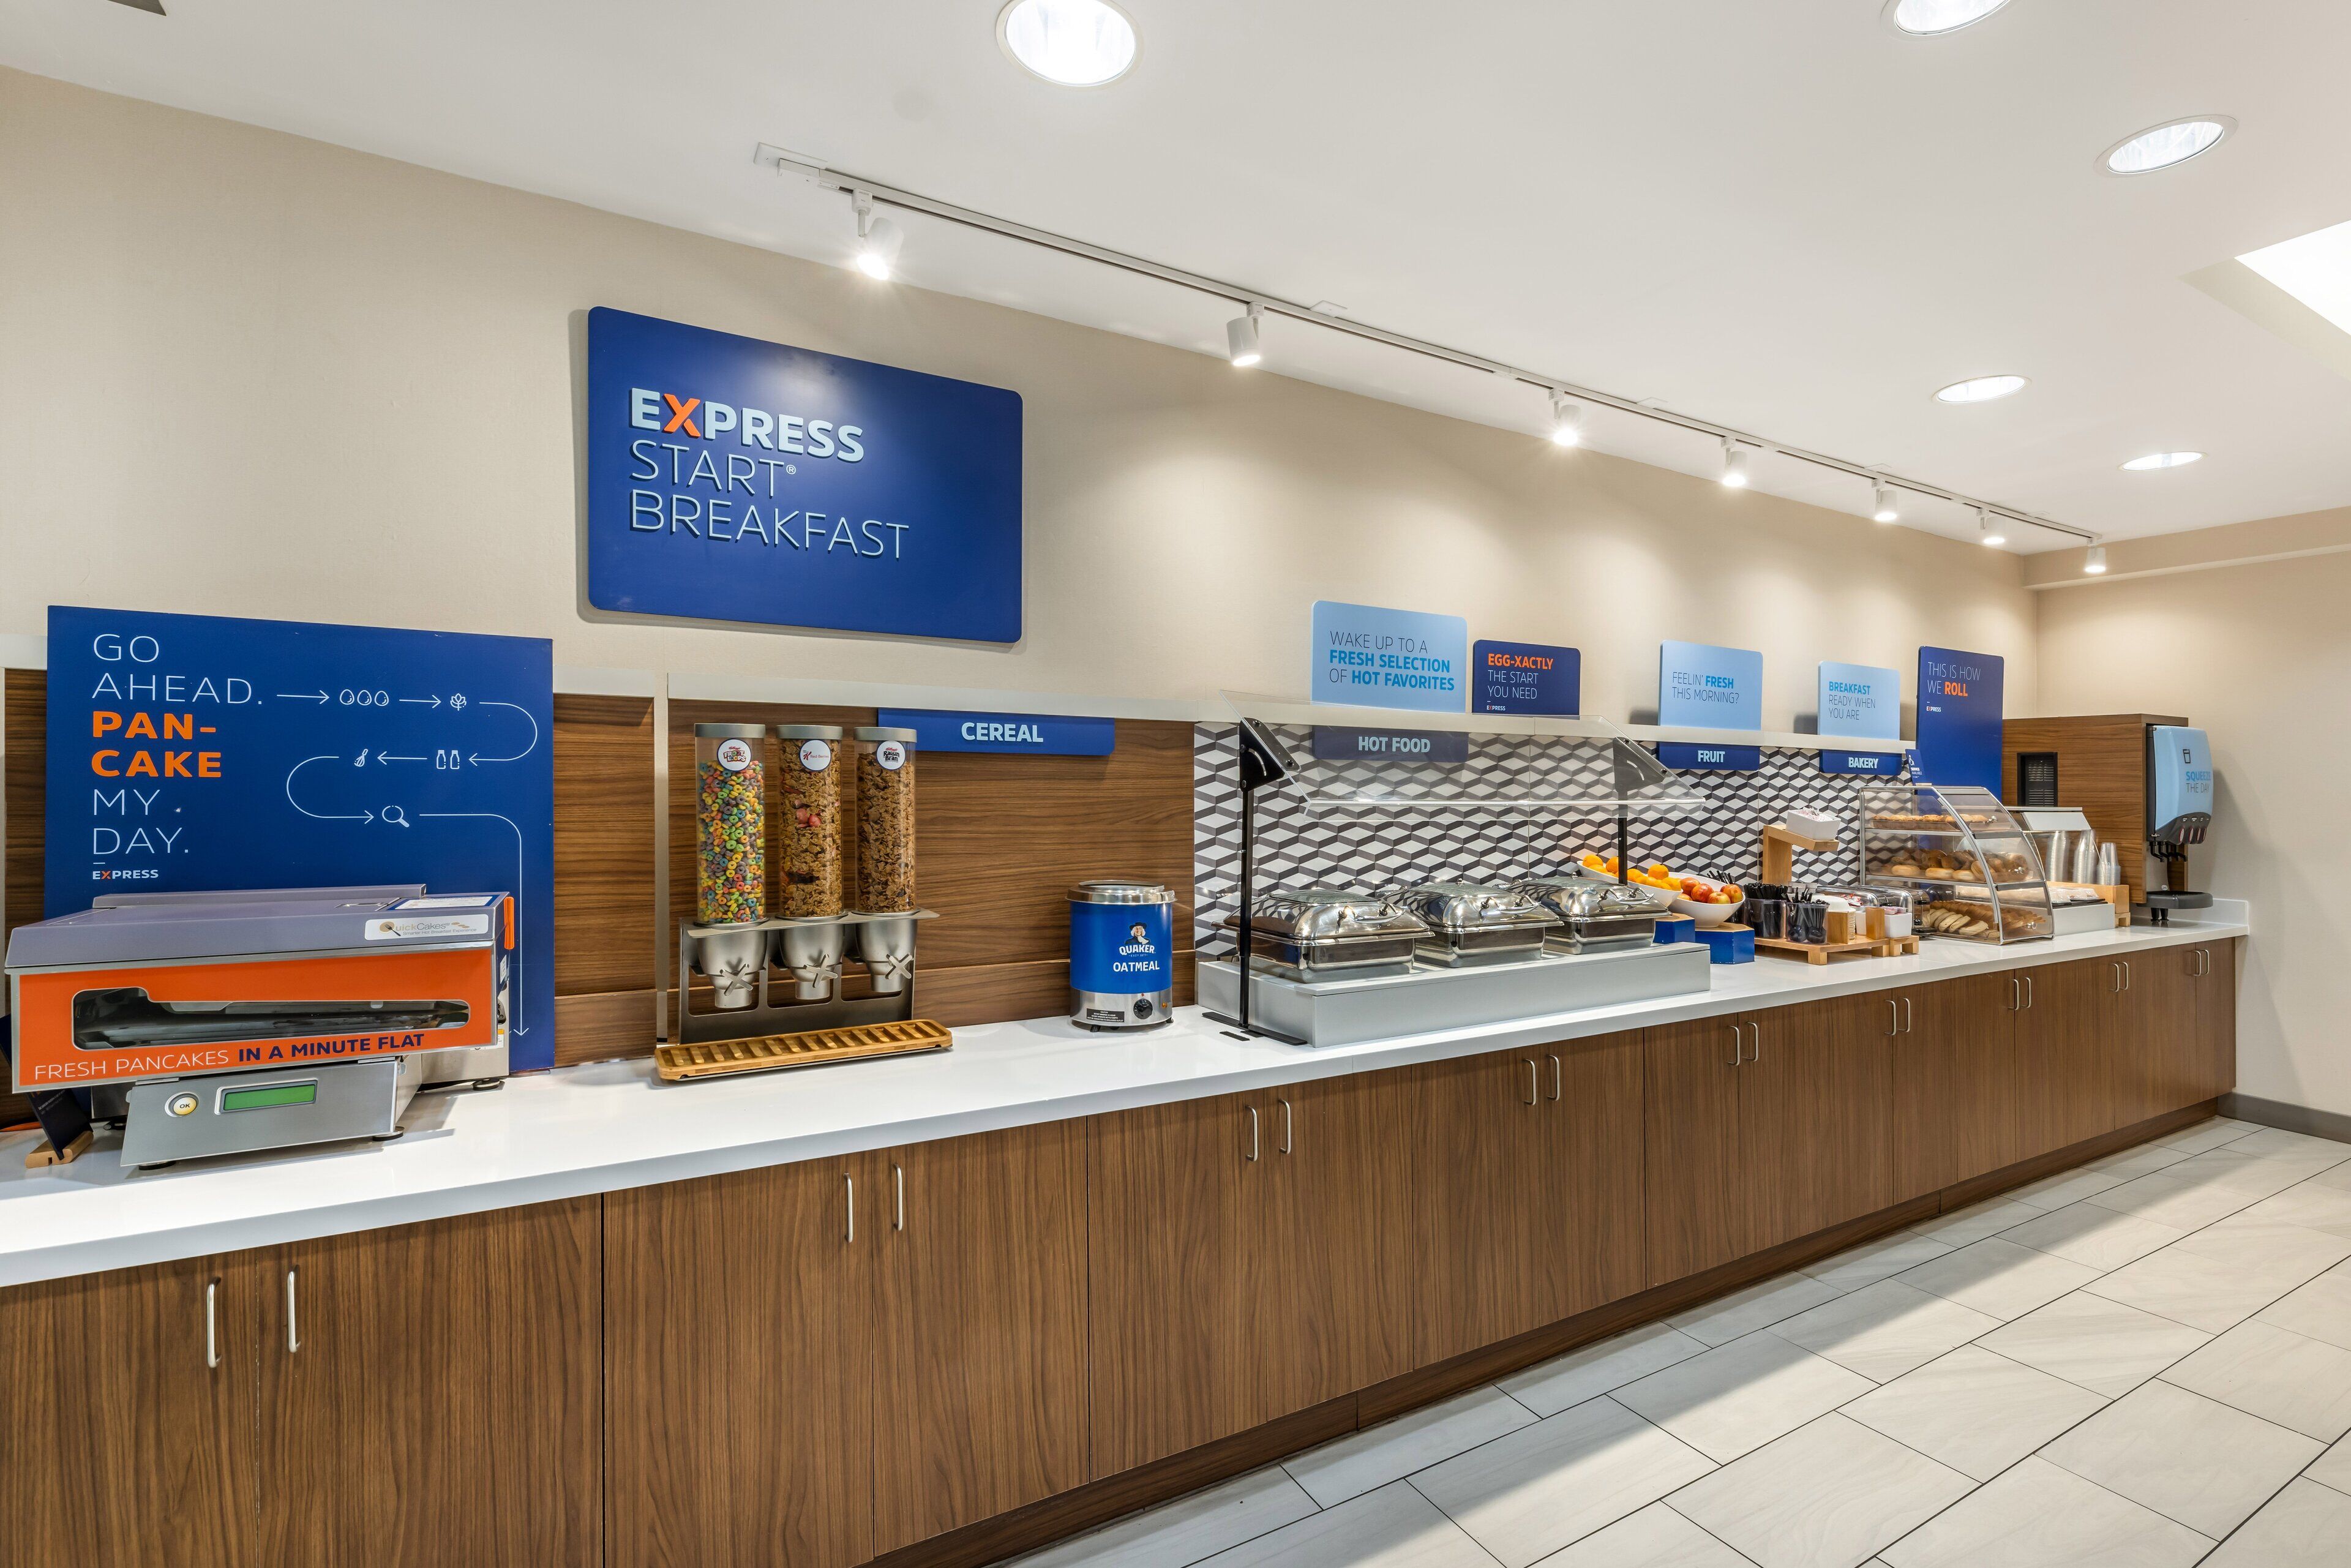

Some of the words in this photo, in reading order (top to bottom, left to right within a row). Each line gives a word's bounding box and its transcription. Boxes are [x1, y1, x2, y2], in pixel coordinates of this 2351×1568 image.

[631, 387, 864, 462] EXPRESS
[629, 489, 910, 560] BREAKFAST
[92, 633, 160, 663] GO
[1330, 631, 1371, 648] WAKE
[1376, 635, 1393, 651] UP
[1397, 638, 1415, 652] TO
[1419, 640, 1428, 653] A
[1330, 650, 1374, 668] FRESH
[1379, 655, 1450, 672] SELECTION
[1488, 653, 1554, 670] EGG-XACTLY
[1487, 670, 1505, 683] THE
[1509, 672, 1538, 685] START
[1927, 661, 1947, 677] THIS
[1949, 664, 1956, 678] IS
[1959, 665, 1981, 680] HOW
[92, 672, 263, 705] AHEAD.
[1330, 669, 1348, 683] OF
[1352, 670, 1379, 686] HOT
[1384, 673, 1455, 691] FAVORITES
[1705, 675, 1734, 689] FRESH
[1829, 681, 1870, 695] BREAKFAST
[1927, 680, 1941, 694] WE
[1944, 681, 1968, 697] ROLL
[1487, 685, 1508, 699] YOU
[1512, 687, 1537, 699] NEED
[1672, 686, 1690, 700] THIS
[1693, 688, 1739, 704] MORNING?
[1829, 695, 1852, 708] READY
[1854, 697, 1876, 709] WHEN
[1829, 708, 1843, 719] YOU
[1845, 709, 1860, 720] ARE
[92, 710, 217, 740] PAN-
[961, 722, 1044, 743] CEREAL
[1359, 736, 1388, 752] HOT
[1392, 737, 1430, 753] FOOD
[91, 749, 222, 778] CAKE
[1698, 750, 1725, 763] FRUIT
[1848, 757, 1879, 769] BAKERY
[2186, 771, 2211, 781] SQUEEZE
[2186, 783, 2199, 793] THE
[2201, 783, 2210, 793] DAY
[93, 788, 161, 816] MY
[93, 827, 189, 856] DAY.
[92, 869, 159, 880] EXPRESS
[1119, 944, 1155, 955] QUAKER
[1113, 961, 1160, 972] OATMEAL
[34, 1059, 106, 1080] FRESH
[116, 1050, 228, 1073] PANCAKES
[239, 1048, 261, 1062] IN
[268, 1046, 285, 1059] A
[291, 1038, 371, 1057] MINUTE
[378, 1033, 425, 1049] FLAT
